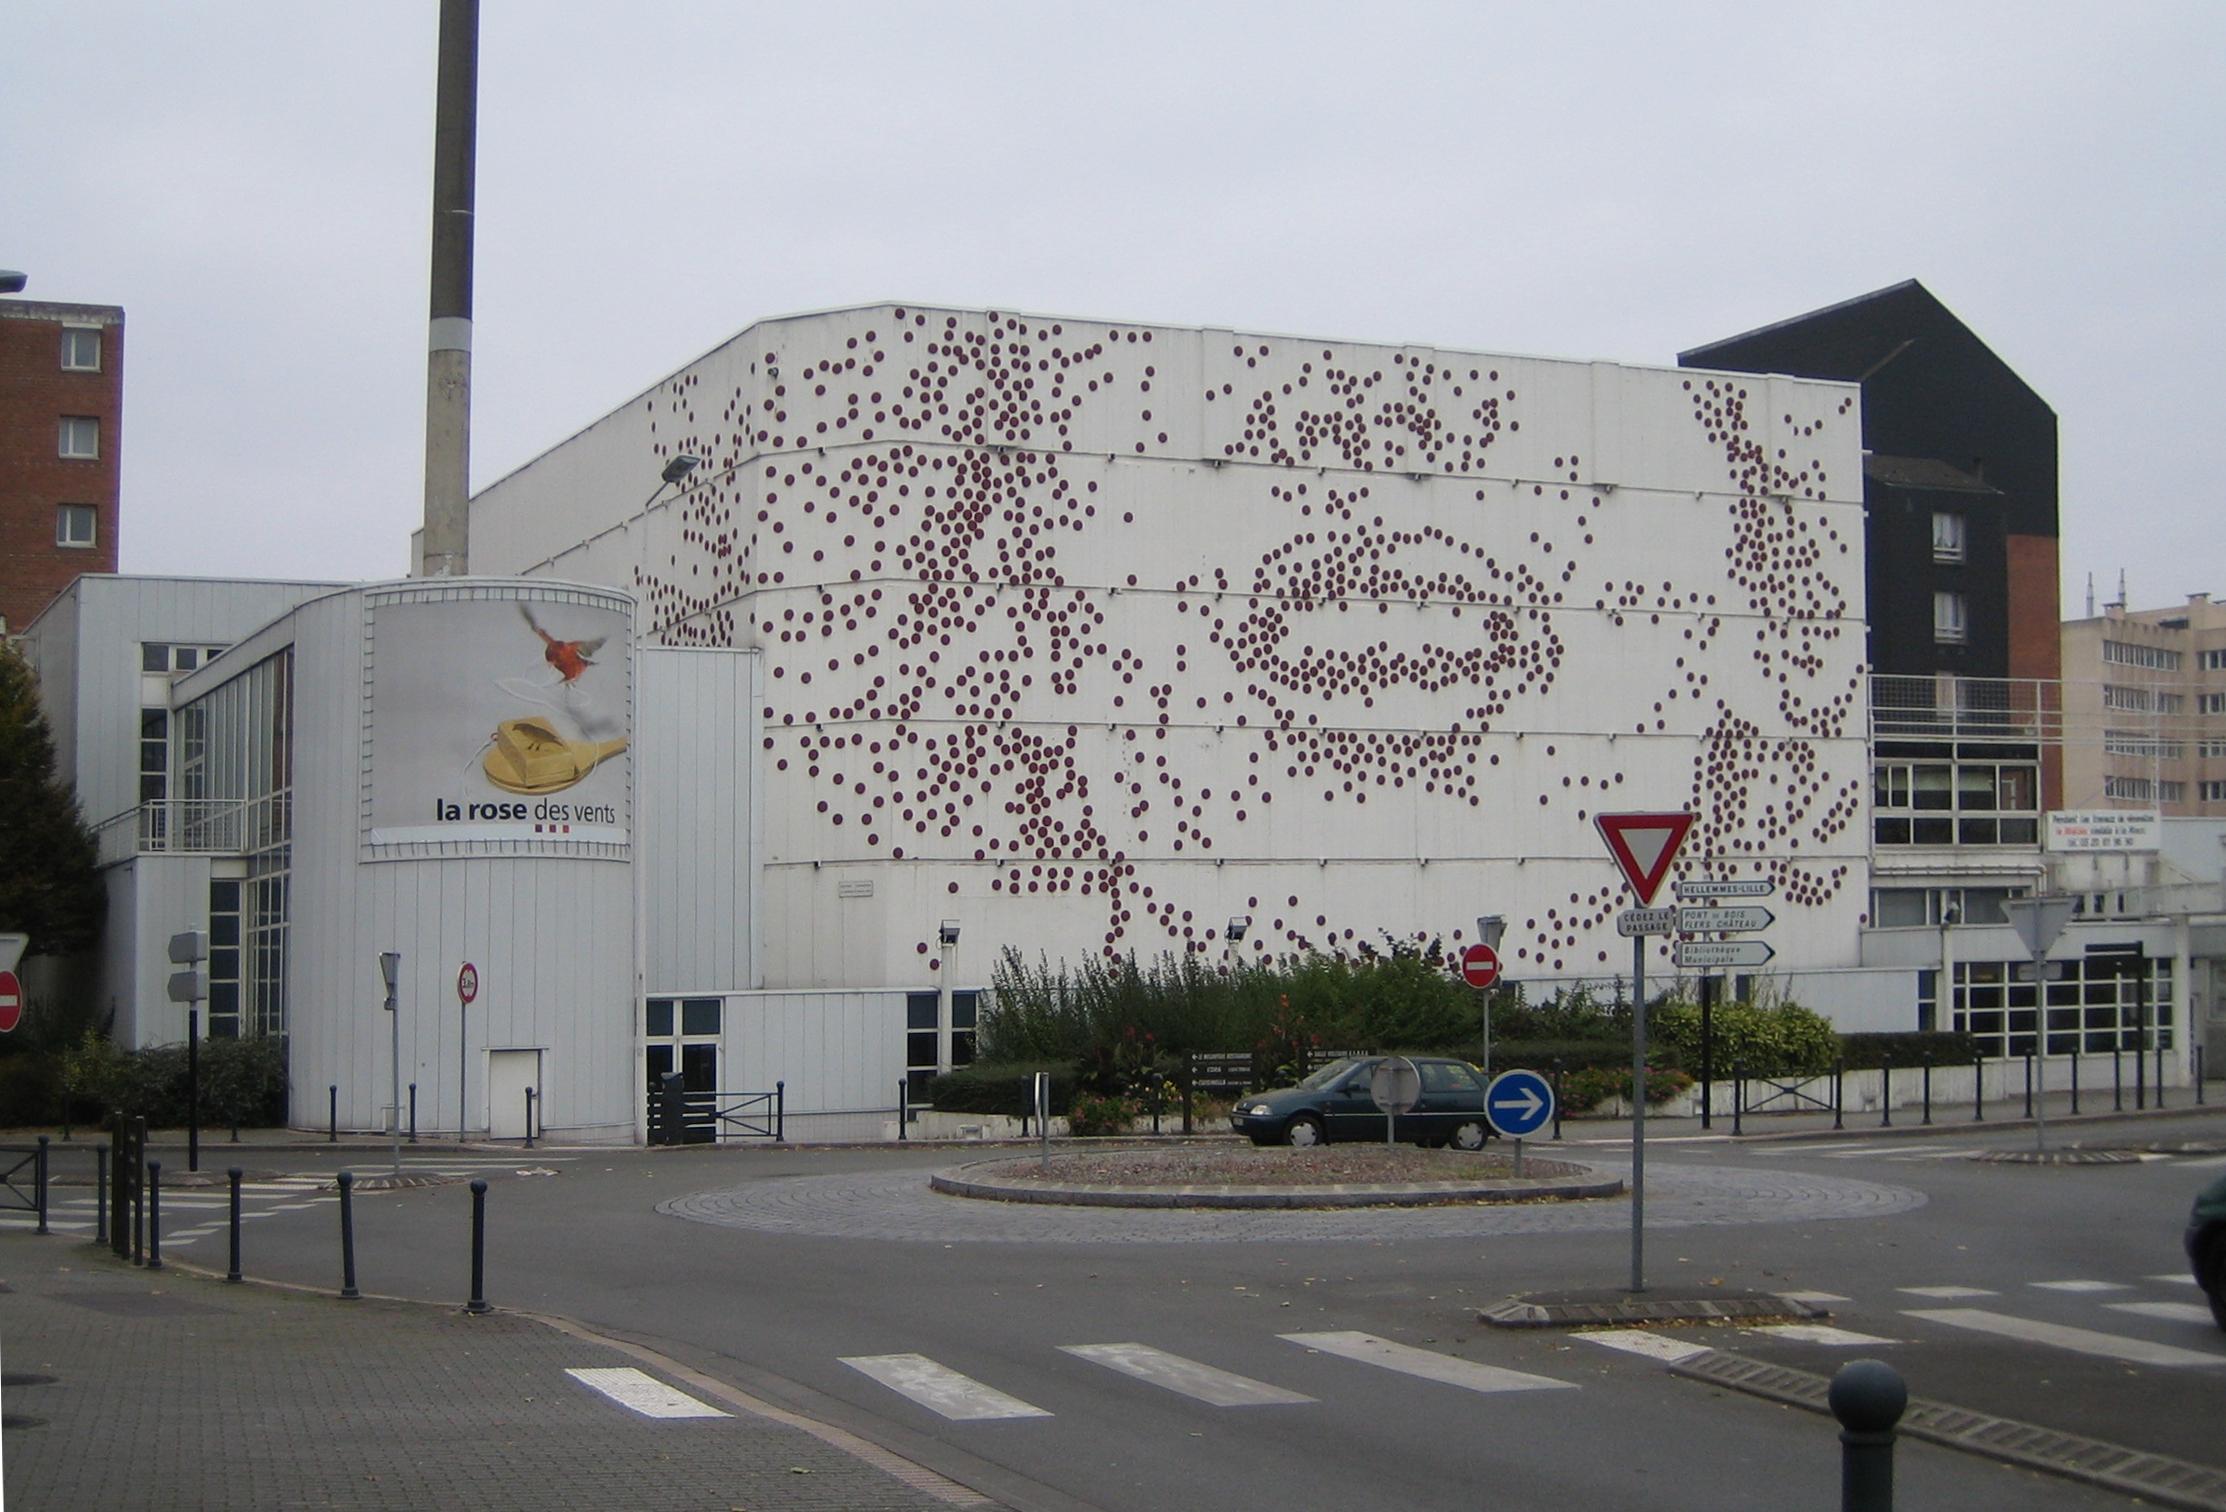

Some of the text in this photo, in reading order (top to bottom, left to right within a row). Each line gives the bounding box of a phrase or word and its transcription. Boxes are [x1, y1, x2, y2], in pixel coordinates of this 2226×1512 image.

[437, 798, 615, 824] la rose des vents
[1684, 884, 1765, 894] HELLEMMES-LILLE
[1624, 911, 1669, 922] CÉDEZ LE
[1684, 911, 1708, 919] PONT
[1724, 910, 1746, 918] BOIS
[1626, 923, 1668, 932] PASSAGE
[1684, 920, 1711, 929] FLERS
[1684, 955, 1734, 965] Municipale
